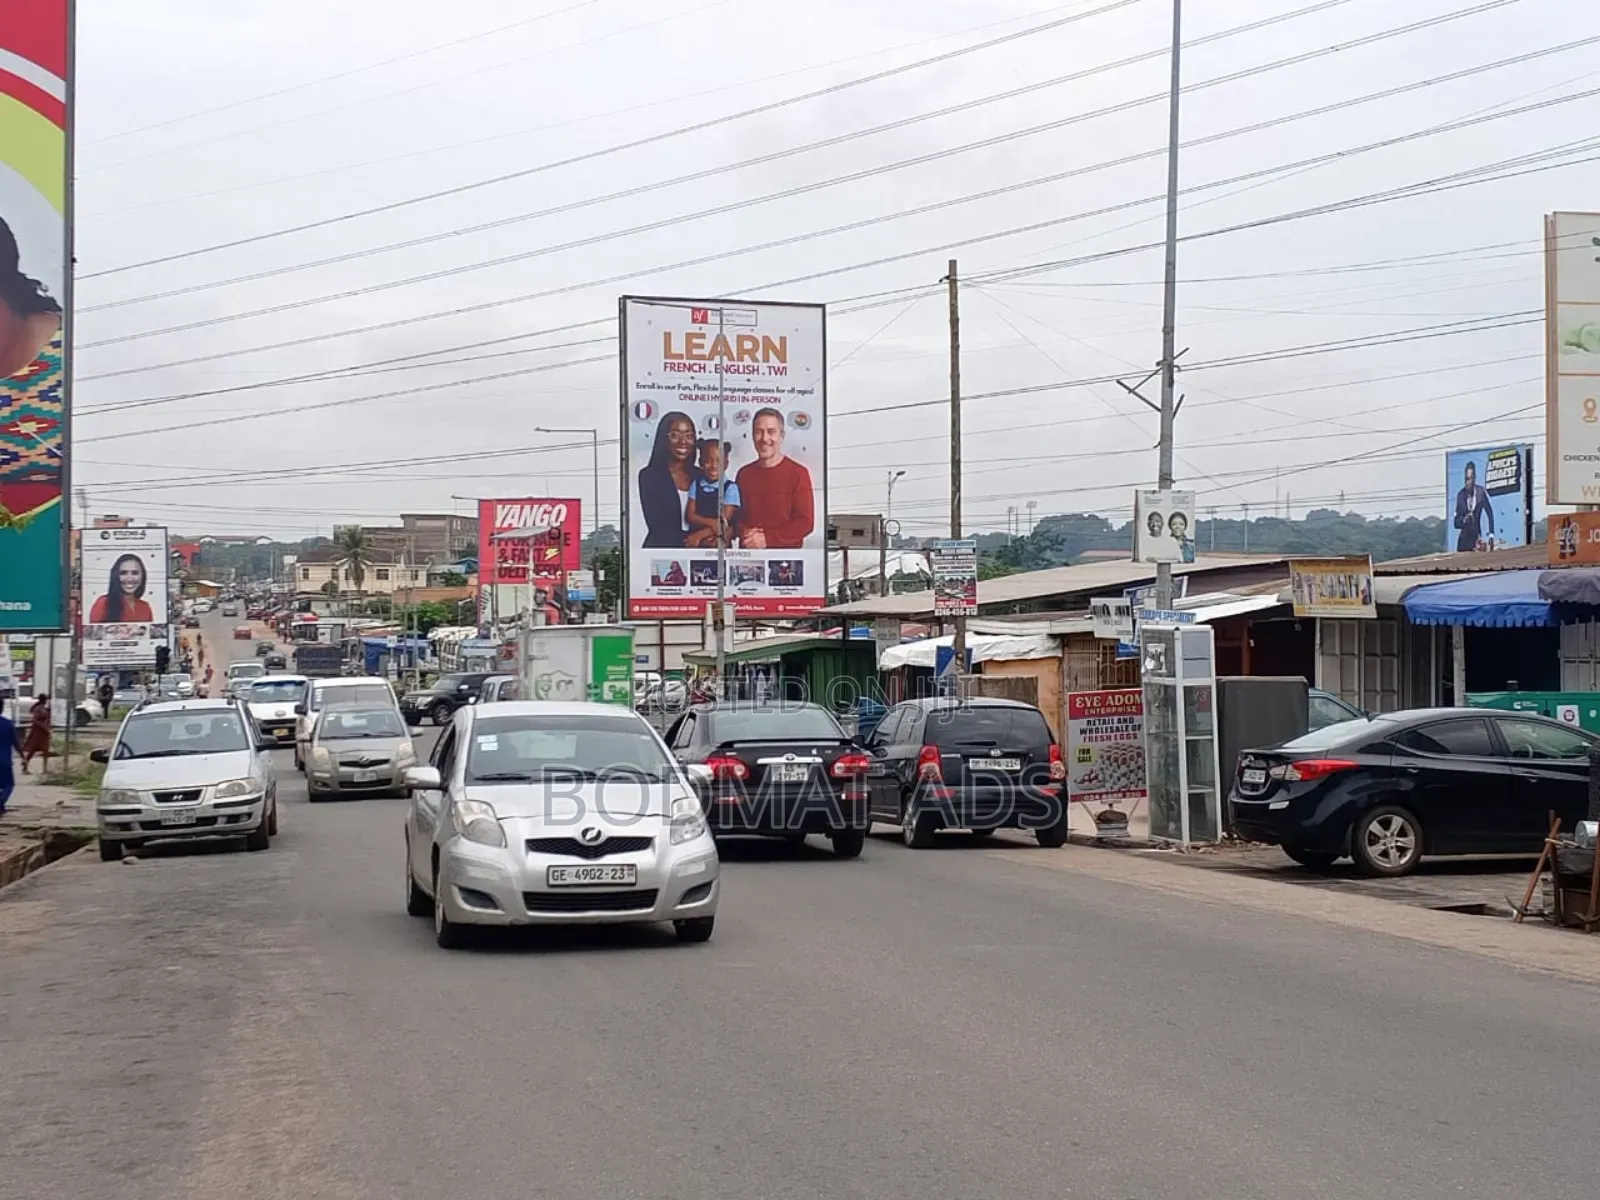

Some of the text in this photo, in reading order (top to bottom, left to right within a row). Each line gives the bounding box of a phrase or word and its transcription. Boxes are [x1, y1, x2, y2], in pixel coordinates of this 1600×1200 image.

[663, 331, 788, 363] LEARN
[664, 362, 788, 377] FRENCH ENGLISH TWI
[636, 382, 656, 390] Enroll
[678, 393, 707, 402] ONLINE
[495, 503, 568, 528] YANGO
[1084, 705, 1137, 716] ENTERPRISE
[1086, 717, 1135, 727] RETAIL AND
[1080, 724, 1130, 736] WHOLESALE
[551, 869, 567, 881] GE
